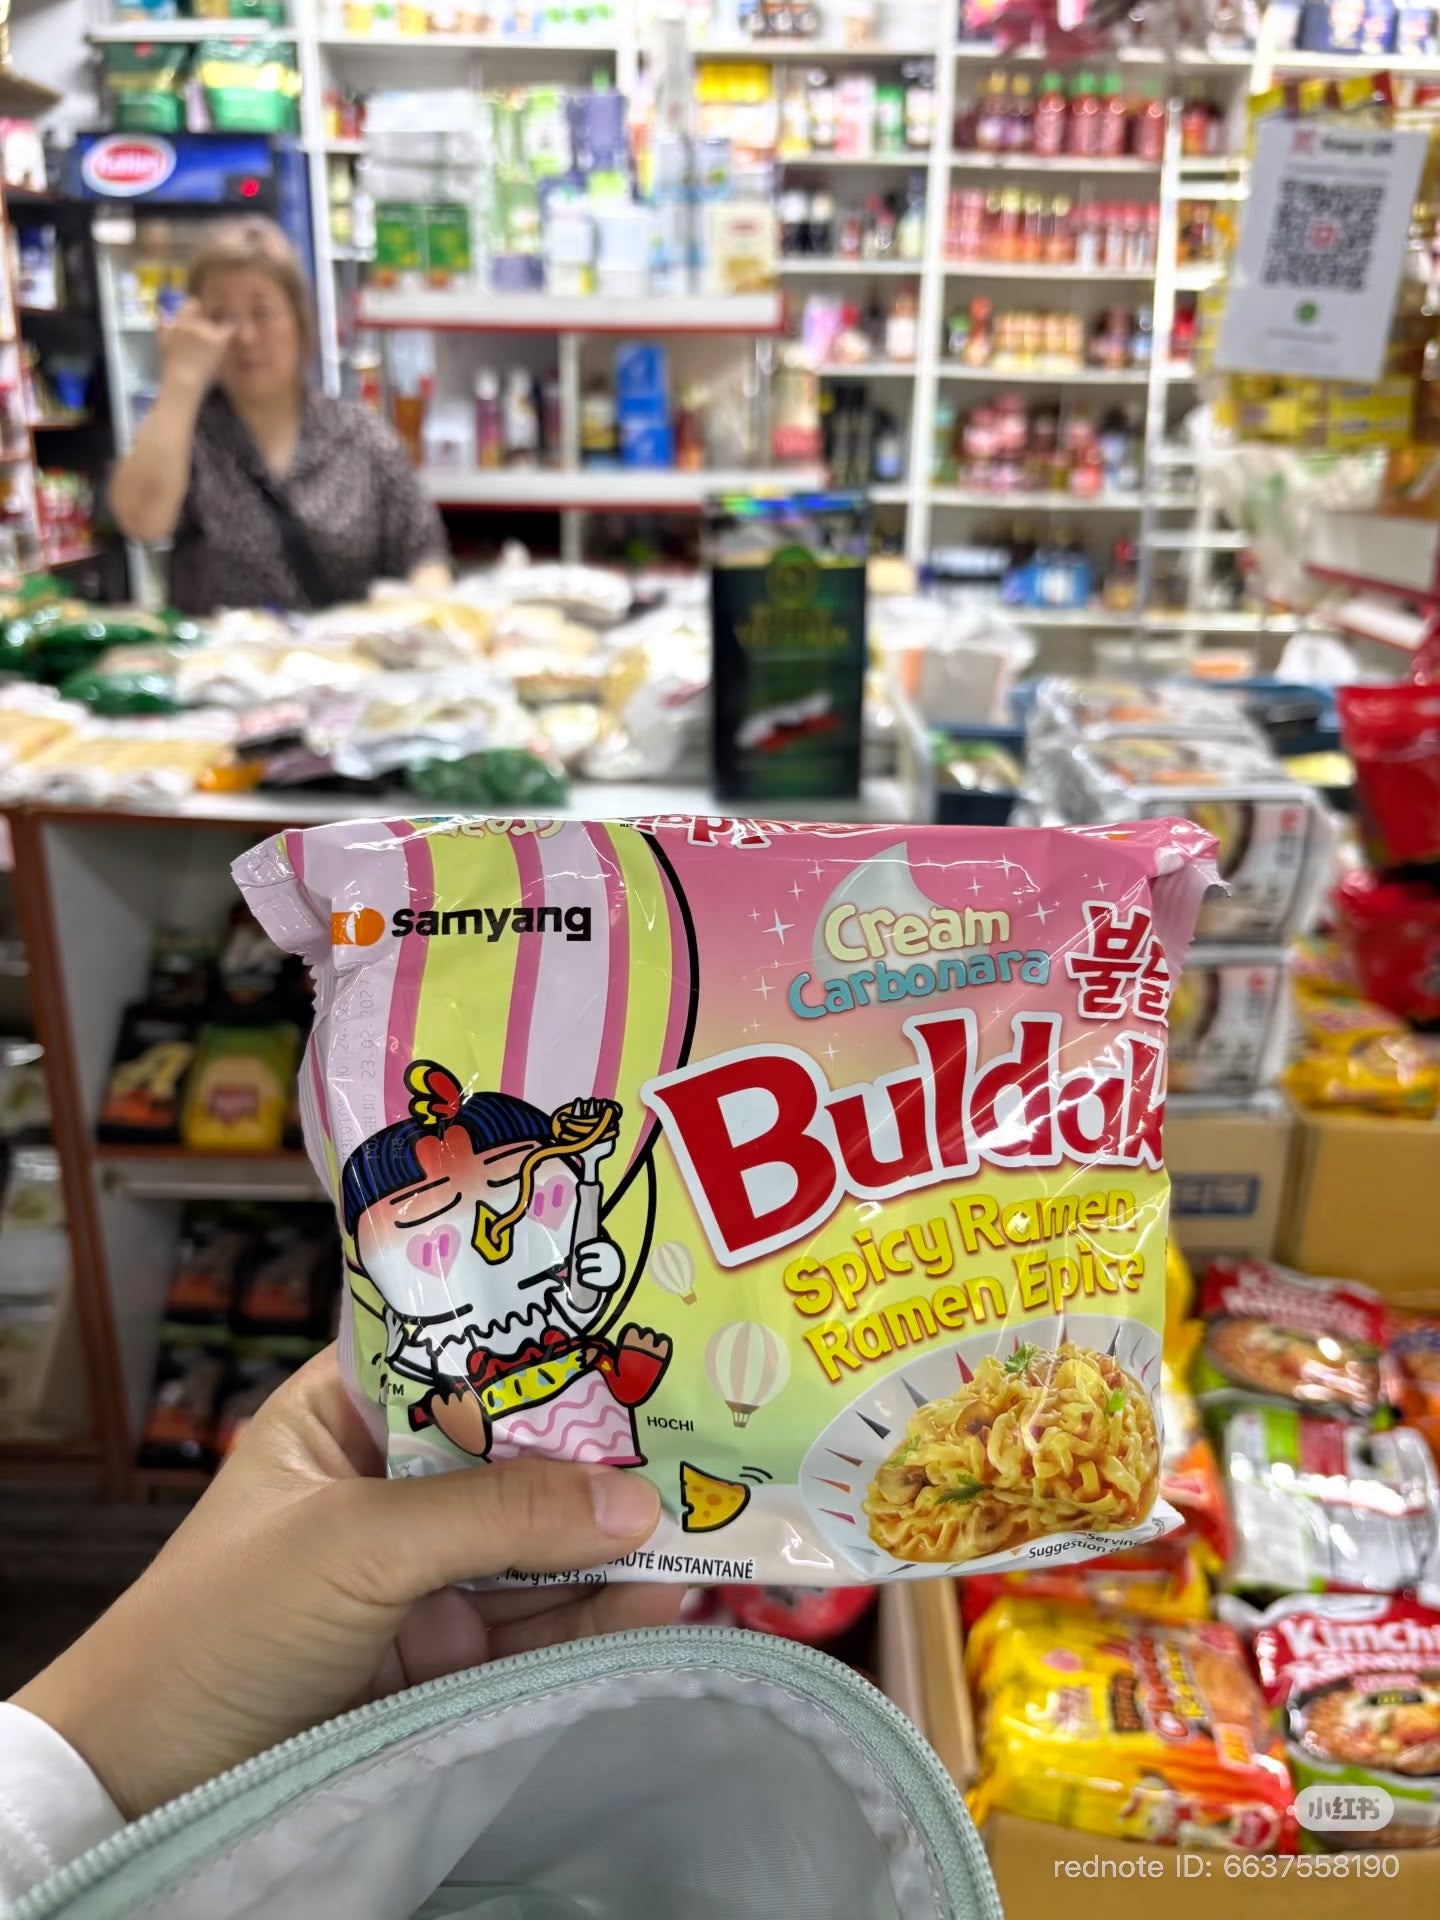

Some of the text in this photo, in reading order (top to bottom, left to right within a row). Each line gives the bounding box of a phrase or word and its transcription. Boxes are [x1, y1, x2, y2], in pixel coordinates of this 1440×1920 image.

[391, 905, 592, 942] samyang
[824, 903, 1011, 962] Cream
[788, 949, 1051, 1018] Carbonara
[644, 1009, 1165, 1264] Buldak
[784, 1189, 1136, 1316] Spicy Ramen
[802, 1275, 1007, 1383] Ramen
[647, 1415, 694, 1432] HOCHI
[1028, 1539, 1107, 1559] Suggestion
[1086, 1532, 1138, 1547] Servin
[606, 1550, 755, 1580] AUTÉ INSTANTANÉ
